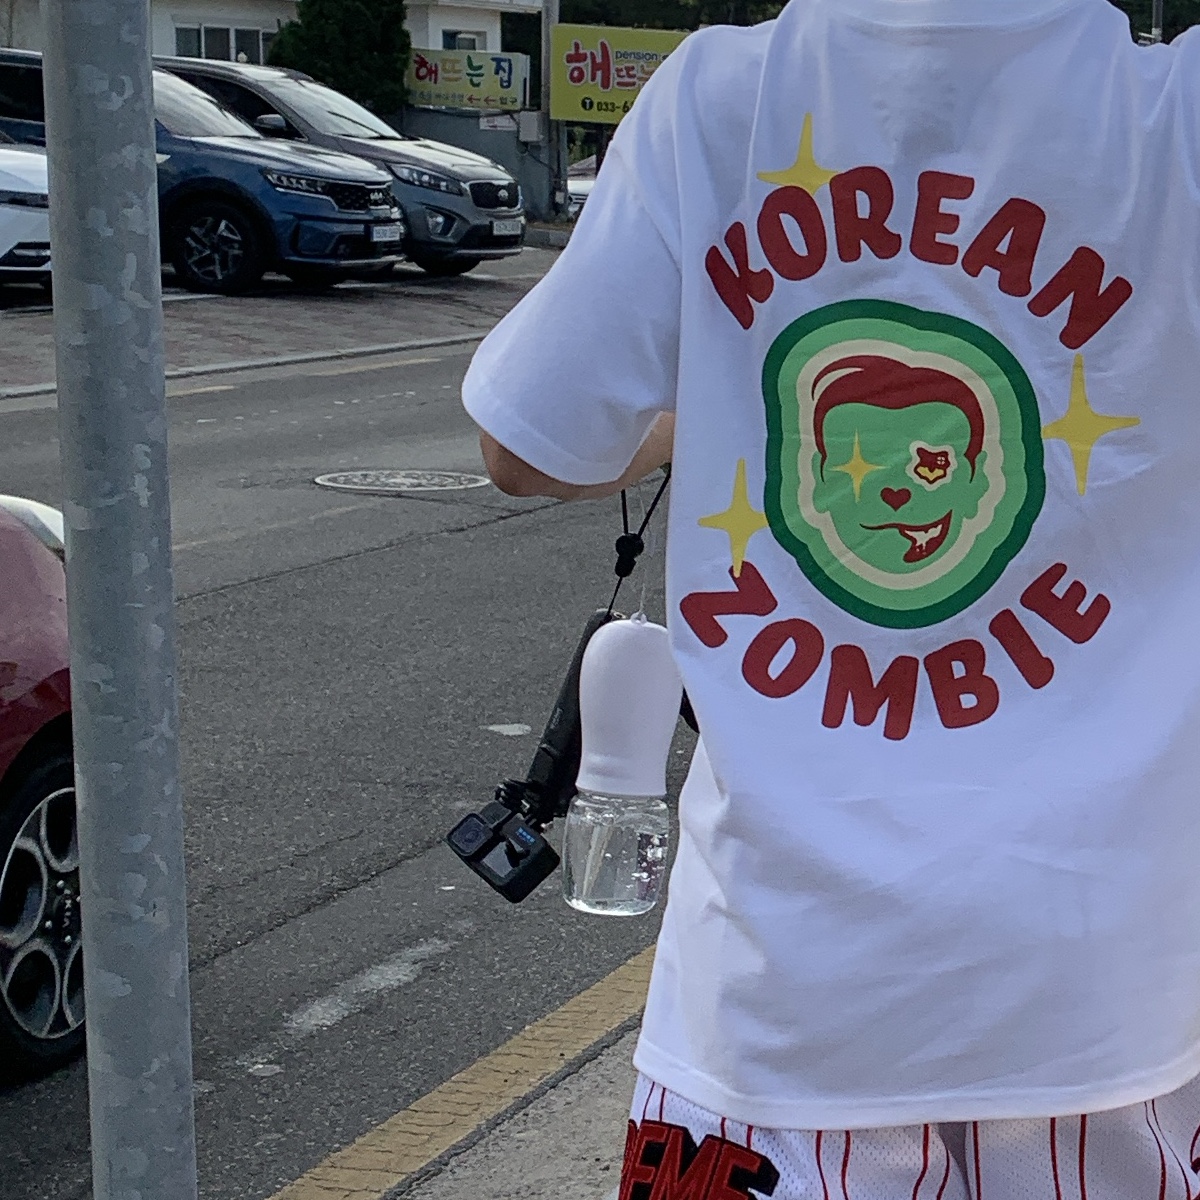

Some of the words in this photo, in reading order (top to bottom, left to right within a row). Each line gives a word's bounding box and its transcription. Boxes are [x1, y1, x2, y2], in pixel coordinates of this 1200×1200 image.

[596, 100, 634, 113] 033-6
[705, 166, 1133, 350] KOREAN
[680, 560, 1112, 741] ZOMBIE
